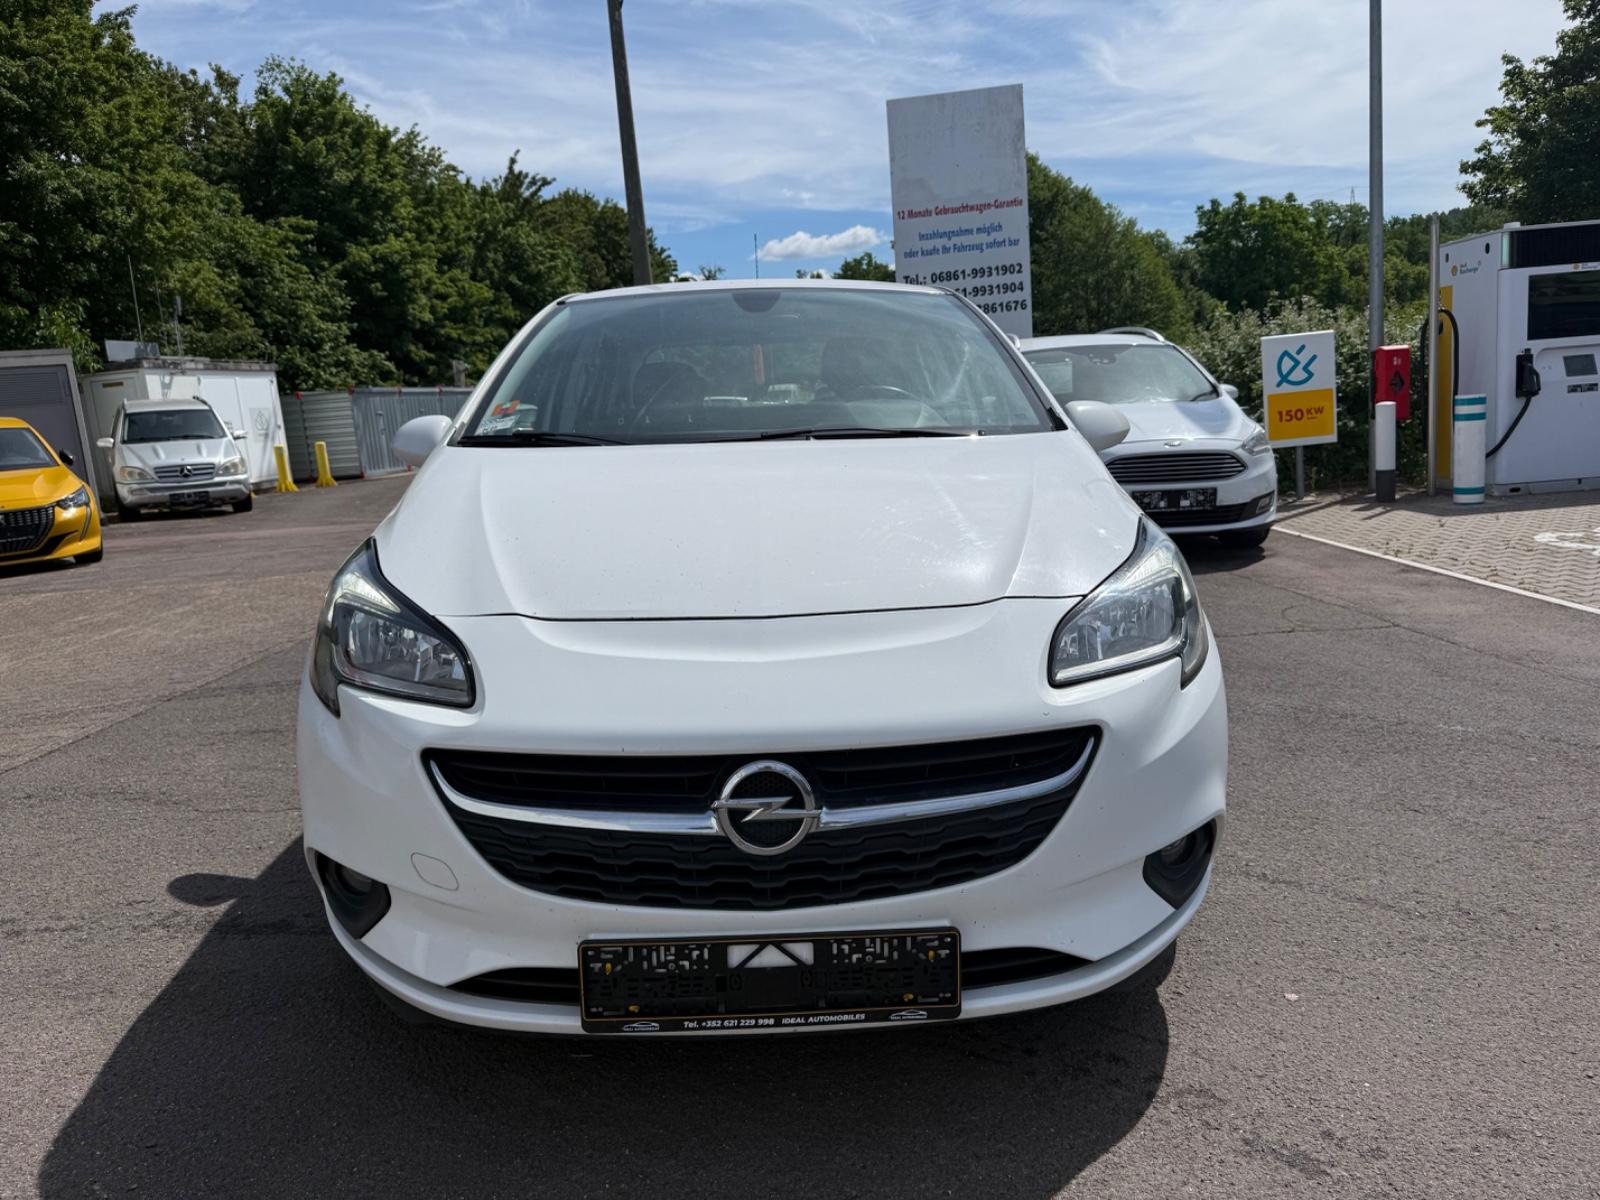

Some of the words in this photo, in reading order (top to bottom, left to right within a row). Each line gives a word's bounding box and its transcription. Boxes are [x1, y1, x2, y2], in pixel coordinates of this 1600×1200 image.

[897, 210, 905, 220] 12
[907, 207, 933, 219] Monate
[934, 198, 1023, 215] Gebrauchtwagen-Garantie
[975, 222, 1003, 237] möglich
[903, 247, 919, 260] oder
[920, 244, 940, 257] kaufe
[952, 240, 985, 254] Fahrzeug
[985, 237, 1006, 250] sofort
[1007, 236, 1020, 248] bar
[903, 274, 927, 285] Tel.:
[930, 263, 1023, 284] 06861-9931902
[1277, 408, 1305, 423] 150
[1306, 406, 1324, 416] KW
[683, 1020, 699, 1029] Tel.
[701, 1019, 722, 1028] +352
[723, 1018, 738, 1027] 621
[739, 1018, 756, 1026] 229
[757, 1017, 775, 1026] 998
[781, 1016, 806, 1025] IDEAL
[807, 1013, 866, 1023] AUTOMOBILES
